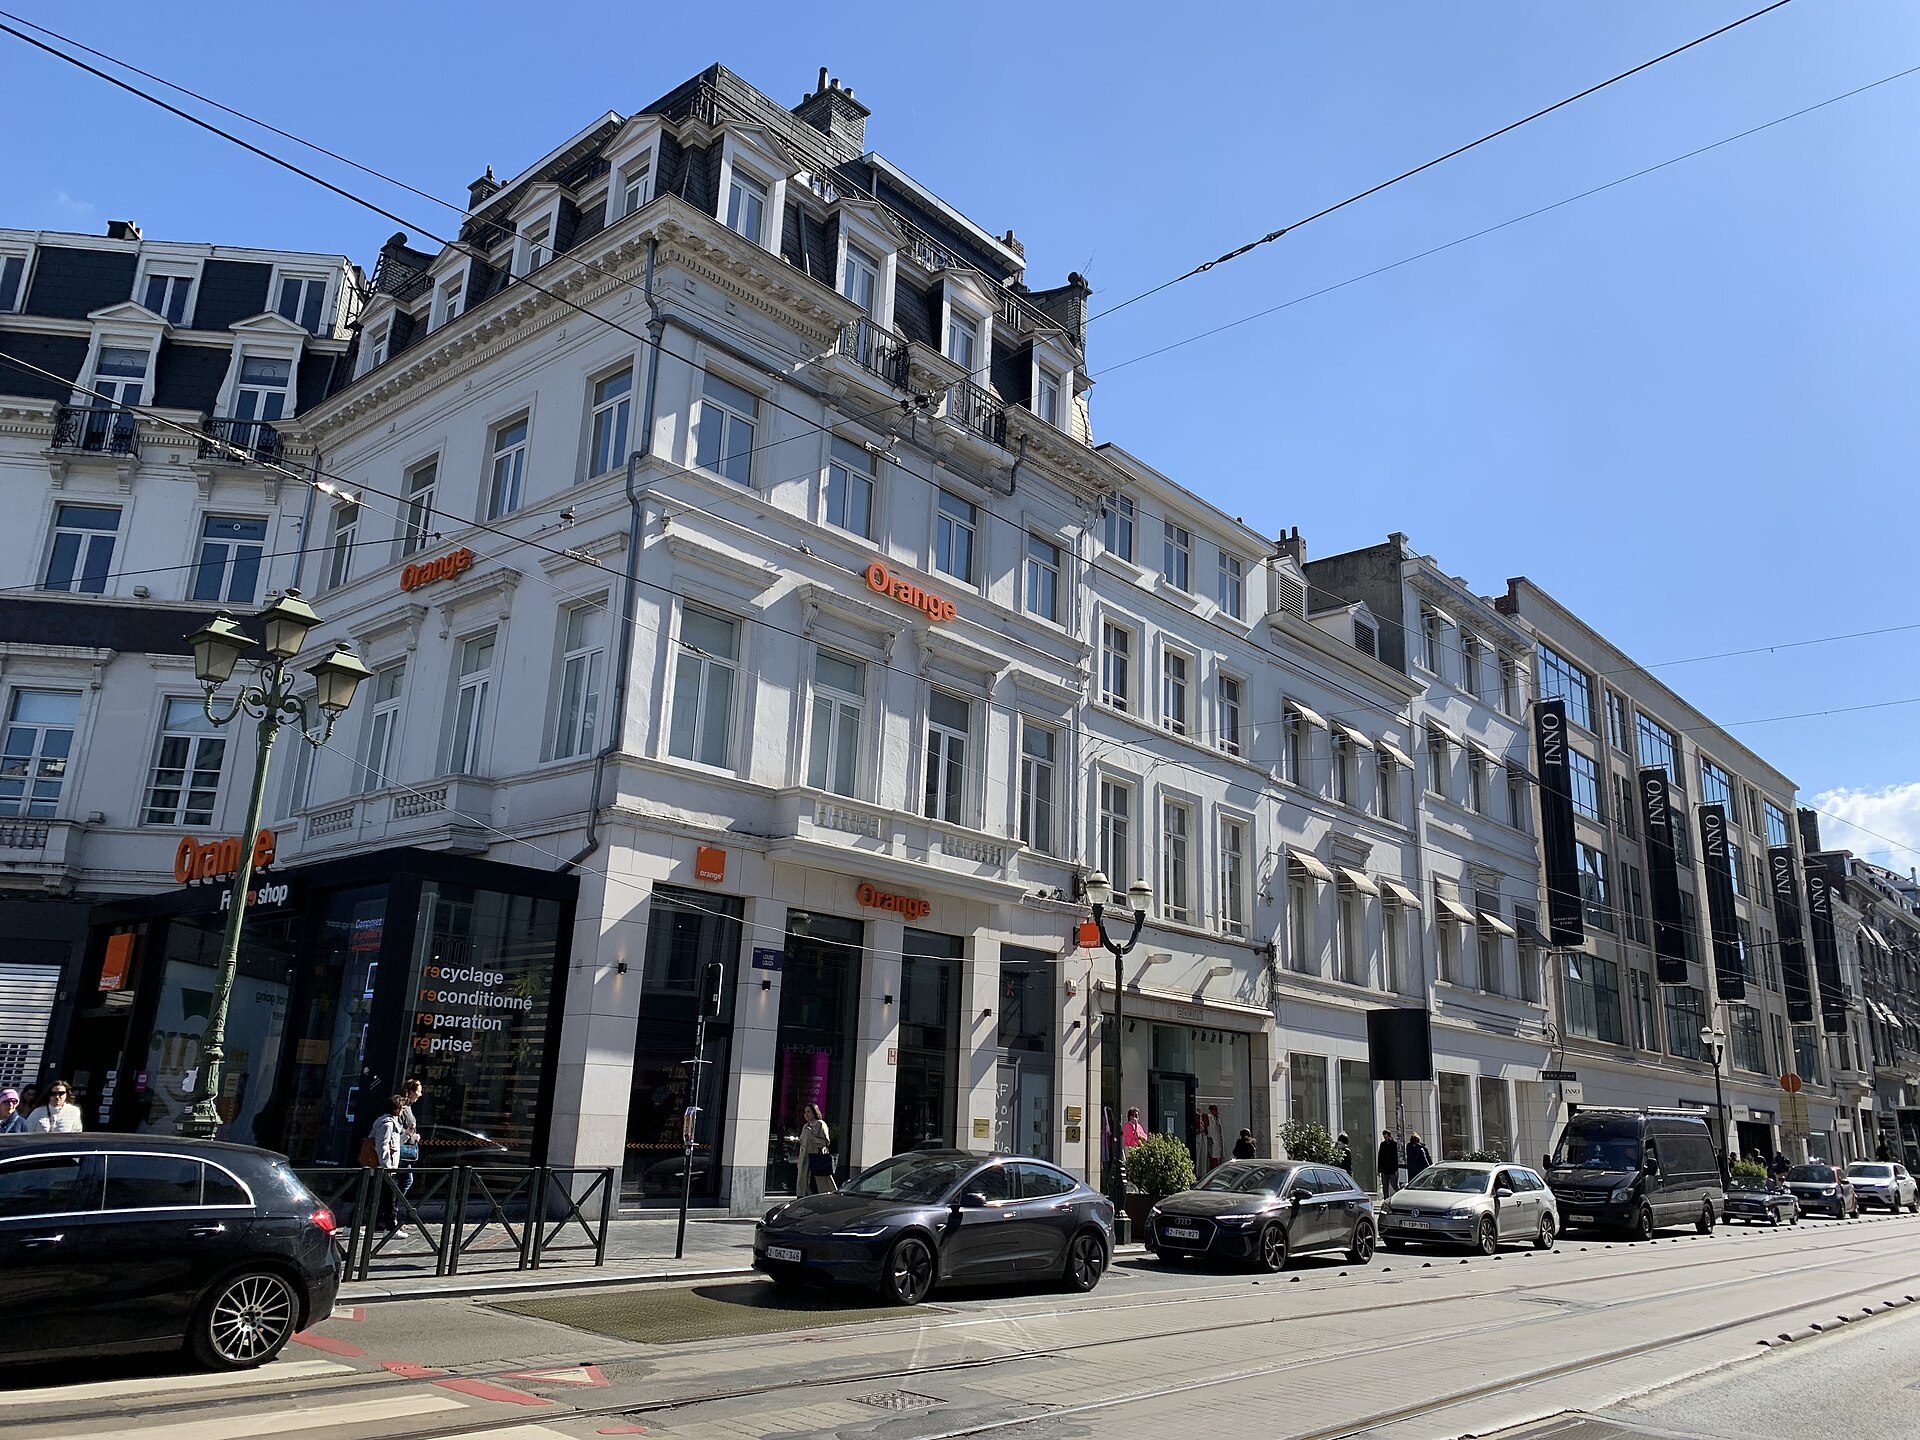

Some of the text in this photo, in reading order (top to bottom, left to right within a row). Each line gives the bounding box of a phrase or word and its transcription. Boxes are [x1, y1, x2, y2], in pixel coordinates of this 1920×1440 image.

[401, 547, 472, 592] Orange
[866, 562, 957, 622] Orange
[1542, 713, 1562, 766] INNO
[1646, 780, 1666, 826] INNO
[1705, 814, 1723, 858] INNO
[175, 829, 277, 883] Orane
[258, 882, 288, 906] shop
[700, 871, 724, 881] orange
[1774, 856, 1792, 895] INNO
[857, 883, 930, 920] Orange
[1811, 877, 1827, 914] INNO
[423, 965, 504, 987] recyclage
[420, 989, 533, 1010] reconditionné
[416, 1012, 502, 1031] reparation
[412, 1035, 473, 1054] reprise
[1071, 1129, 1077, 1139] 2
